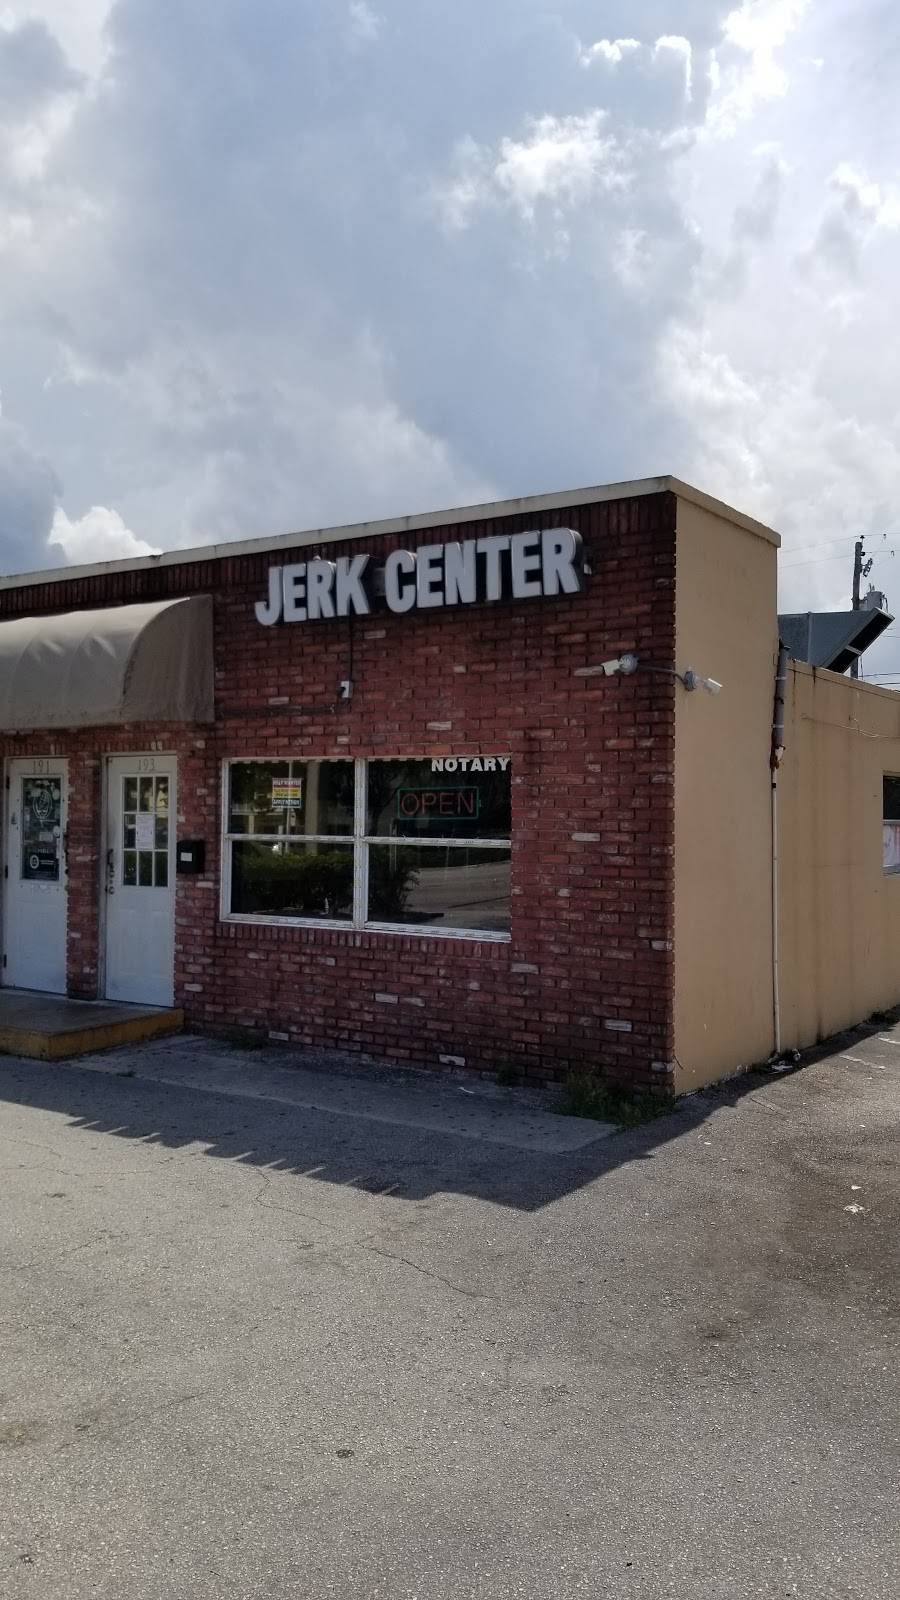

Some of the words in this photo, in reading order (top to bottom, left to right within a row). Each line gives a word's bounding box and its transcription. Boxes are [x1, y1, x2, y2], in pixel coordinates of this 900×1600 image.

[254, 554, 370, 626] JERK
[384, 527, 582, 613] CENTER
[33, 760, 50, 774] 191
[137, 758, 156, 771] 193
[431, 757, 511, 772] NOTARY
[401, 792, 474, 816] OPEN
